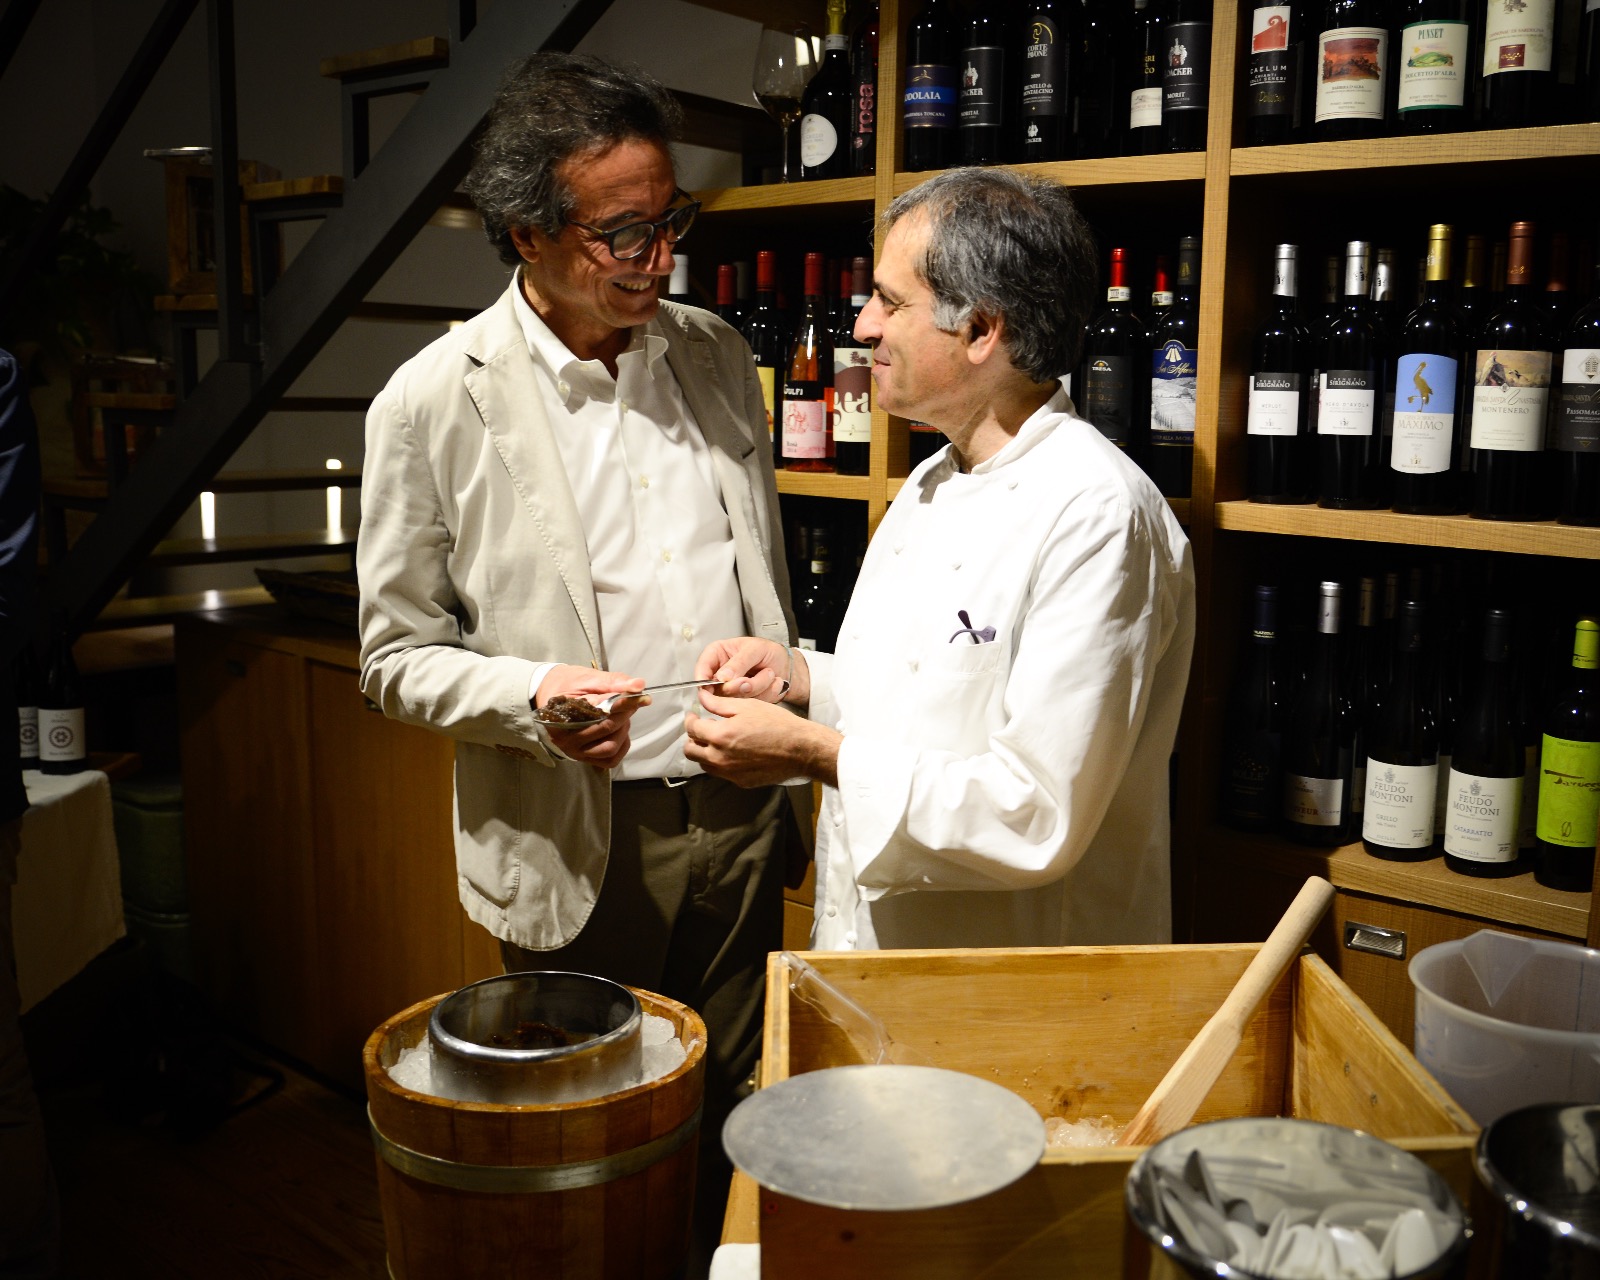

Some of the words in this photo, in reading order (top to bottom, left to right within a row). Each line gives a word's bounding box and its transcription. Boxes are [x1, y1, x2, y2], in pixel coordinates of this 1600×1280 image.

[1250, 65, 1287, 75] CAELUM
[858, 83, 874, 134] rosa
[1481, 406, 1530, 415] MONTENERO
[1397, 419, 1444, 431] MAXIMO
[1374, 781, 1406, 794] FEUDO
[1369, 788, 1414, 803] MONTONI
[1458, 793, 1493, 807] FEUDO
[1453, 801, 1501, 816] MONTONI
[1375, 813, 1399, 823] GRILLO
[1453, 824, 1493, 837] CATARRATTO
